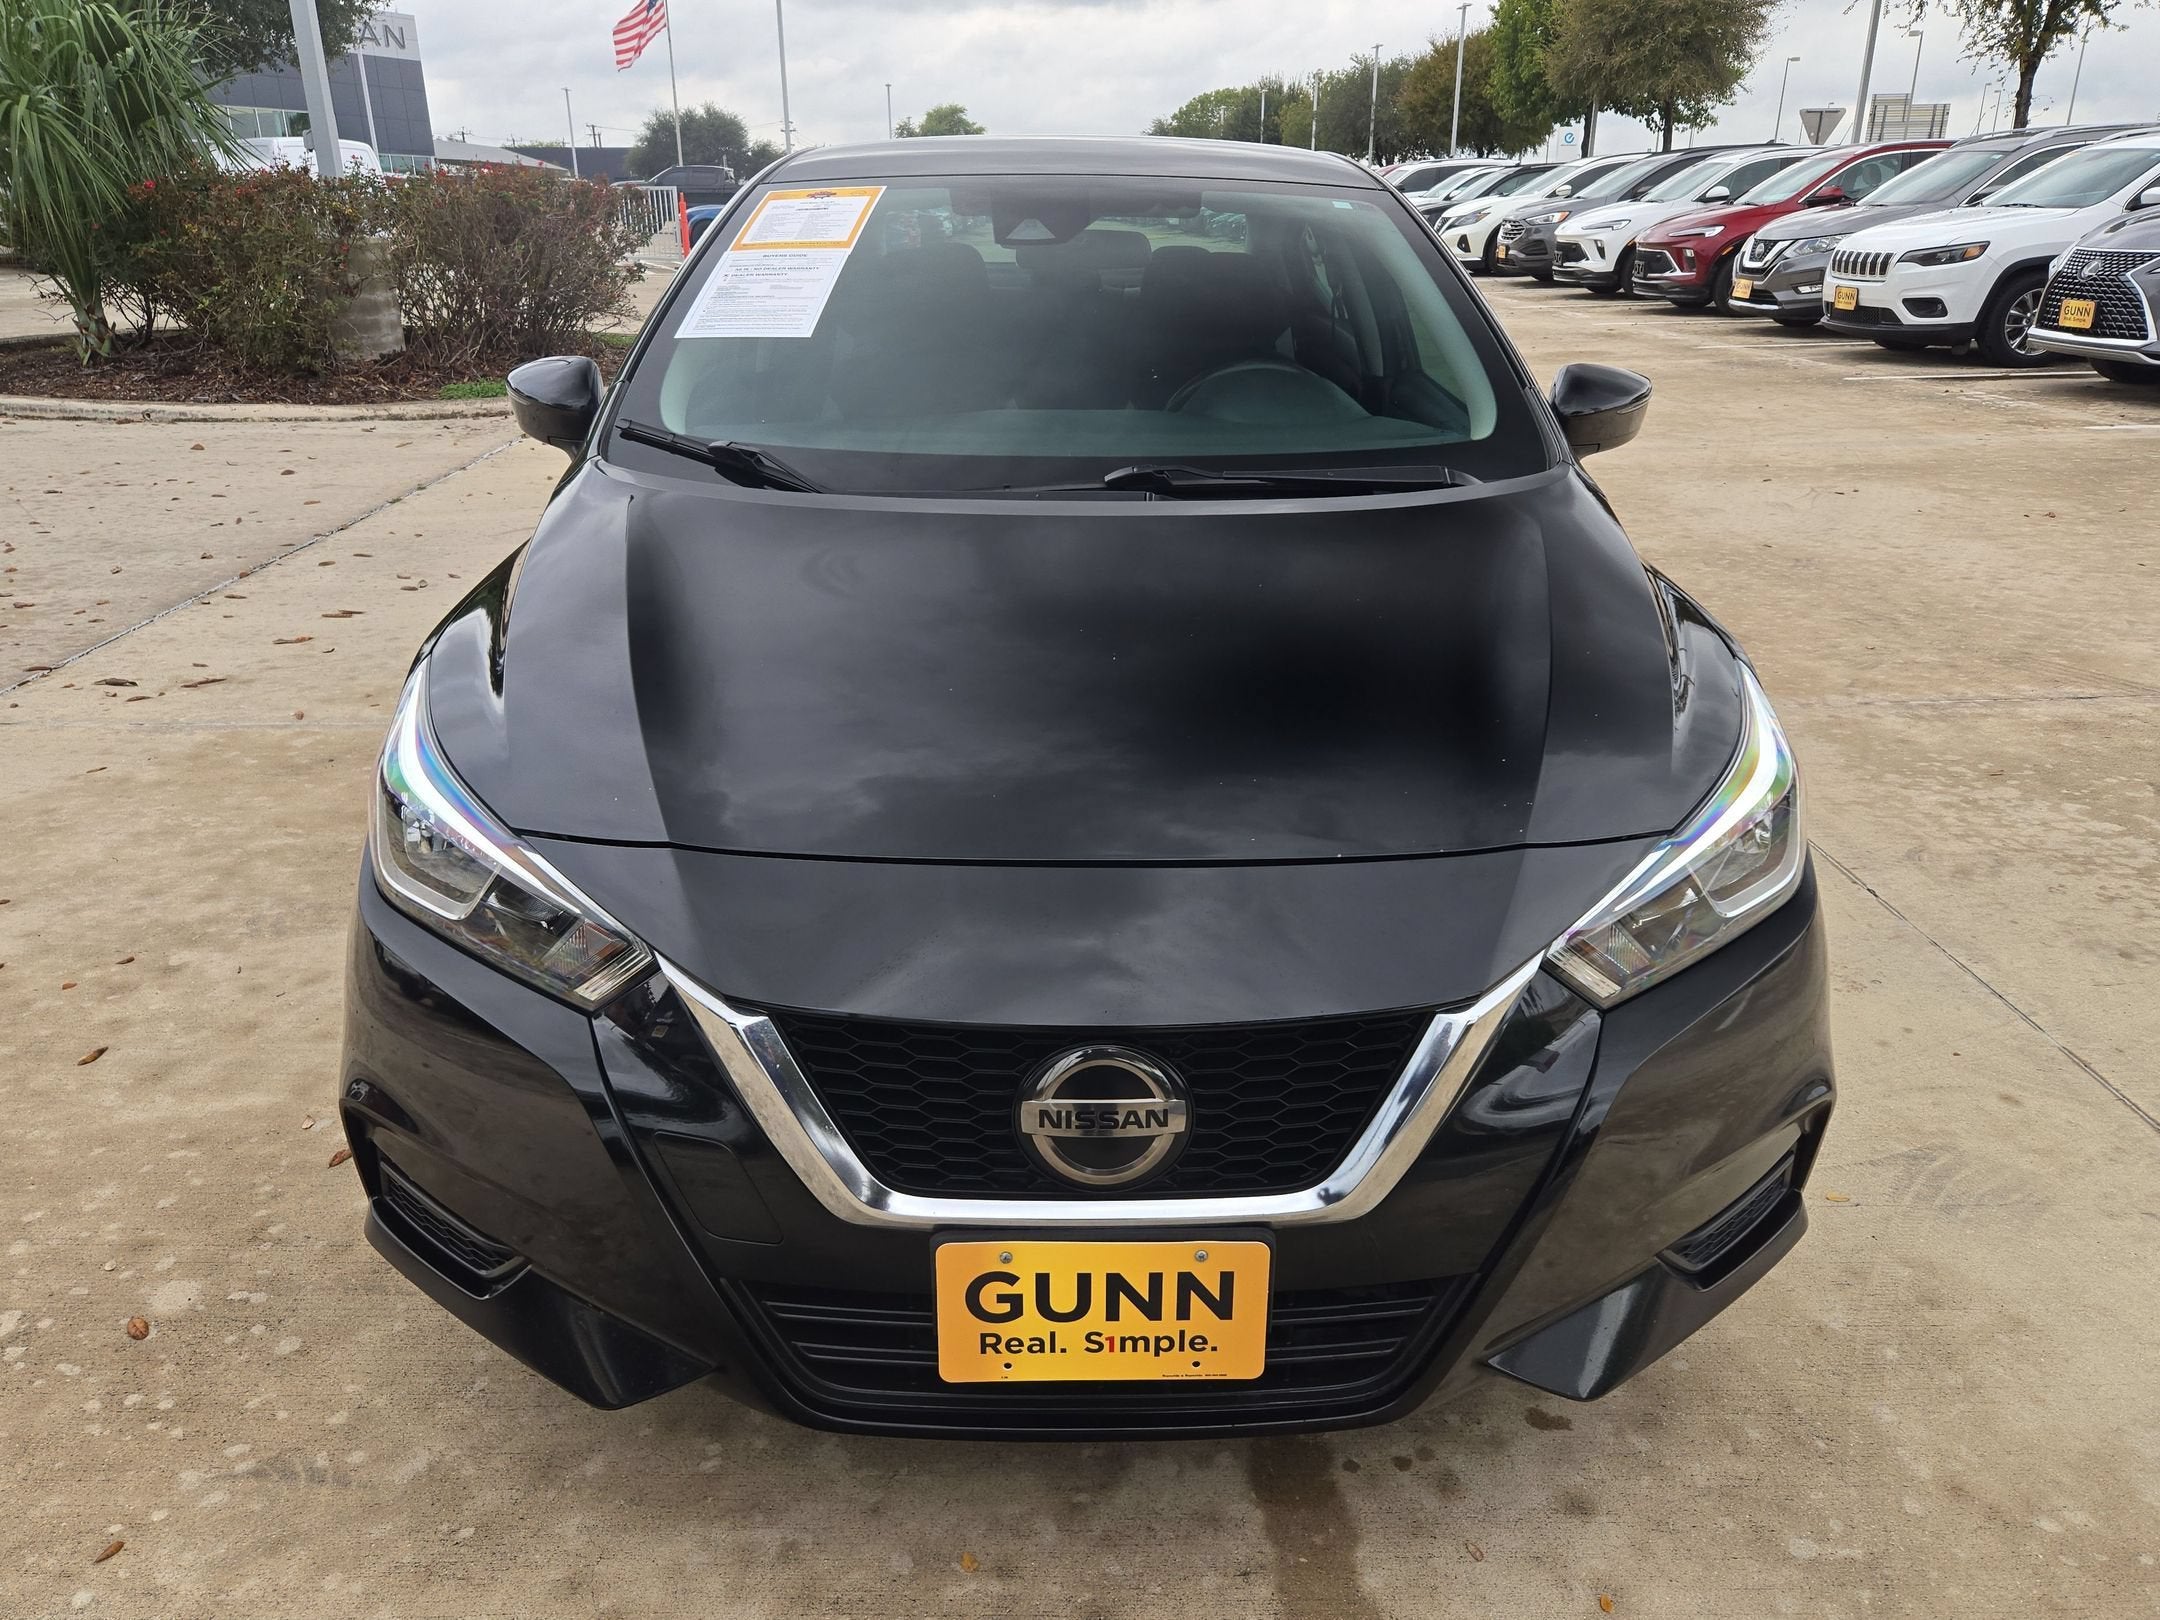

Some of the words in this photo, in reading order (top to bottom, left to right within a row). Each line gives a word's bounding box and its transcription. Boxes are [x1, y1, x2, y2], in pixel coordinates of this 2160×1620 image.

[2064, 305, 2091, 317] GUNN
[1038, 1109, 1169, 1130] NISSAN
[964, 1270, 1235, 1324] GUNN
[979, 1330, 1067, 1355] Real.
